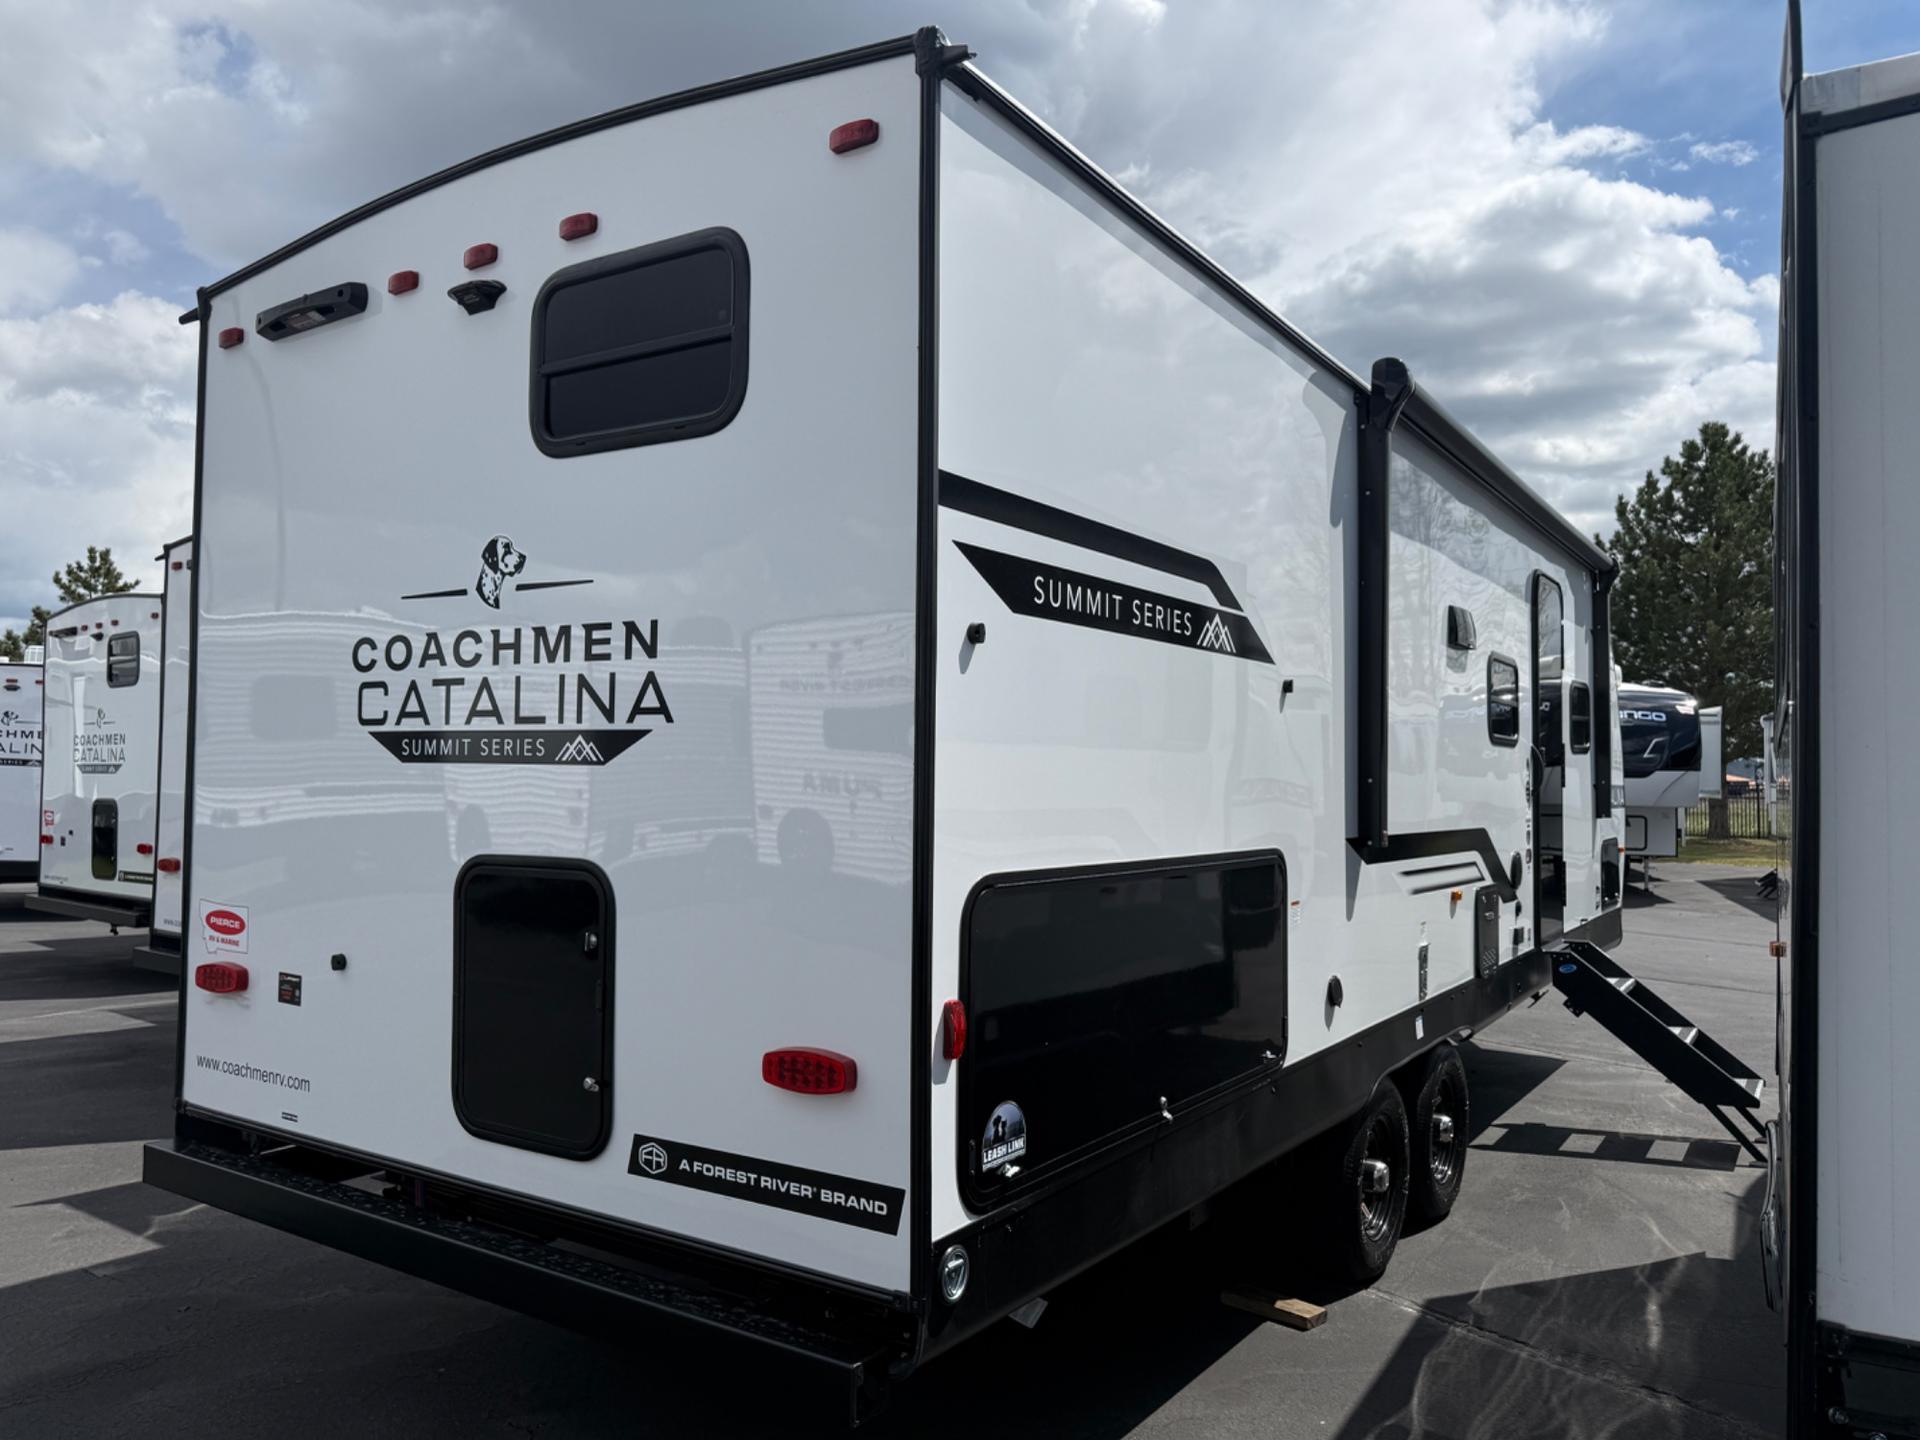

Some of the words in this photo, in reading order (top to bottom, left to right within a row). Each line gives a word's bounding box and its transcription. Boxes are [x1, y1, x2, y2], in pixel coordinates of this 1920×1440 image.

[1033, 576, 1122, 620] SUMMIT
[1132, 600, 1192, 635] SERIES
[352, 619, 658, 672] COACHMEN
[357, 671, 675, 726] CATALINA
[73, 733, 126, 746] COACHMEN
[73, 747, 126, 762] CATALINA
[401, 738, 472, 756] SUMMIT
[480, 738, 546, 756] SERIES
[210, 916, 240, 929] PIERCE
[196, 1055, 311, 1093] www.coachmenrv.com
[983, 1143, 1008, 1164] LEASH
[1008, 1137, 1024, 1153] LINK
[679, 1159, 691, 1172] A
[693, 1162, 758, 1186] FOREST
[821, 1189, 888, 1216] BRAND
